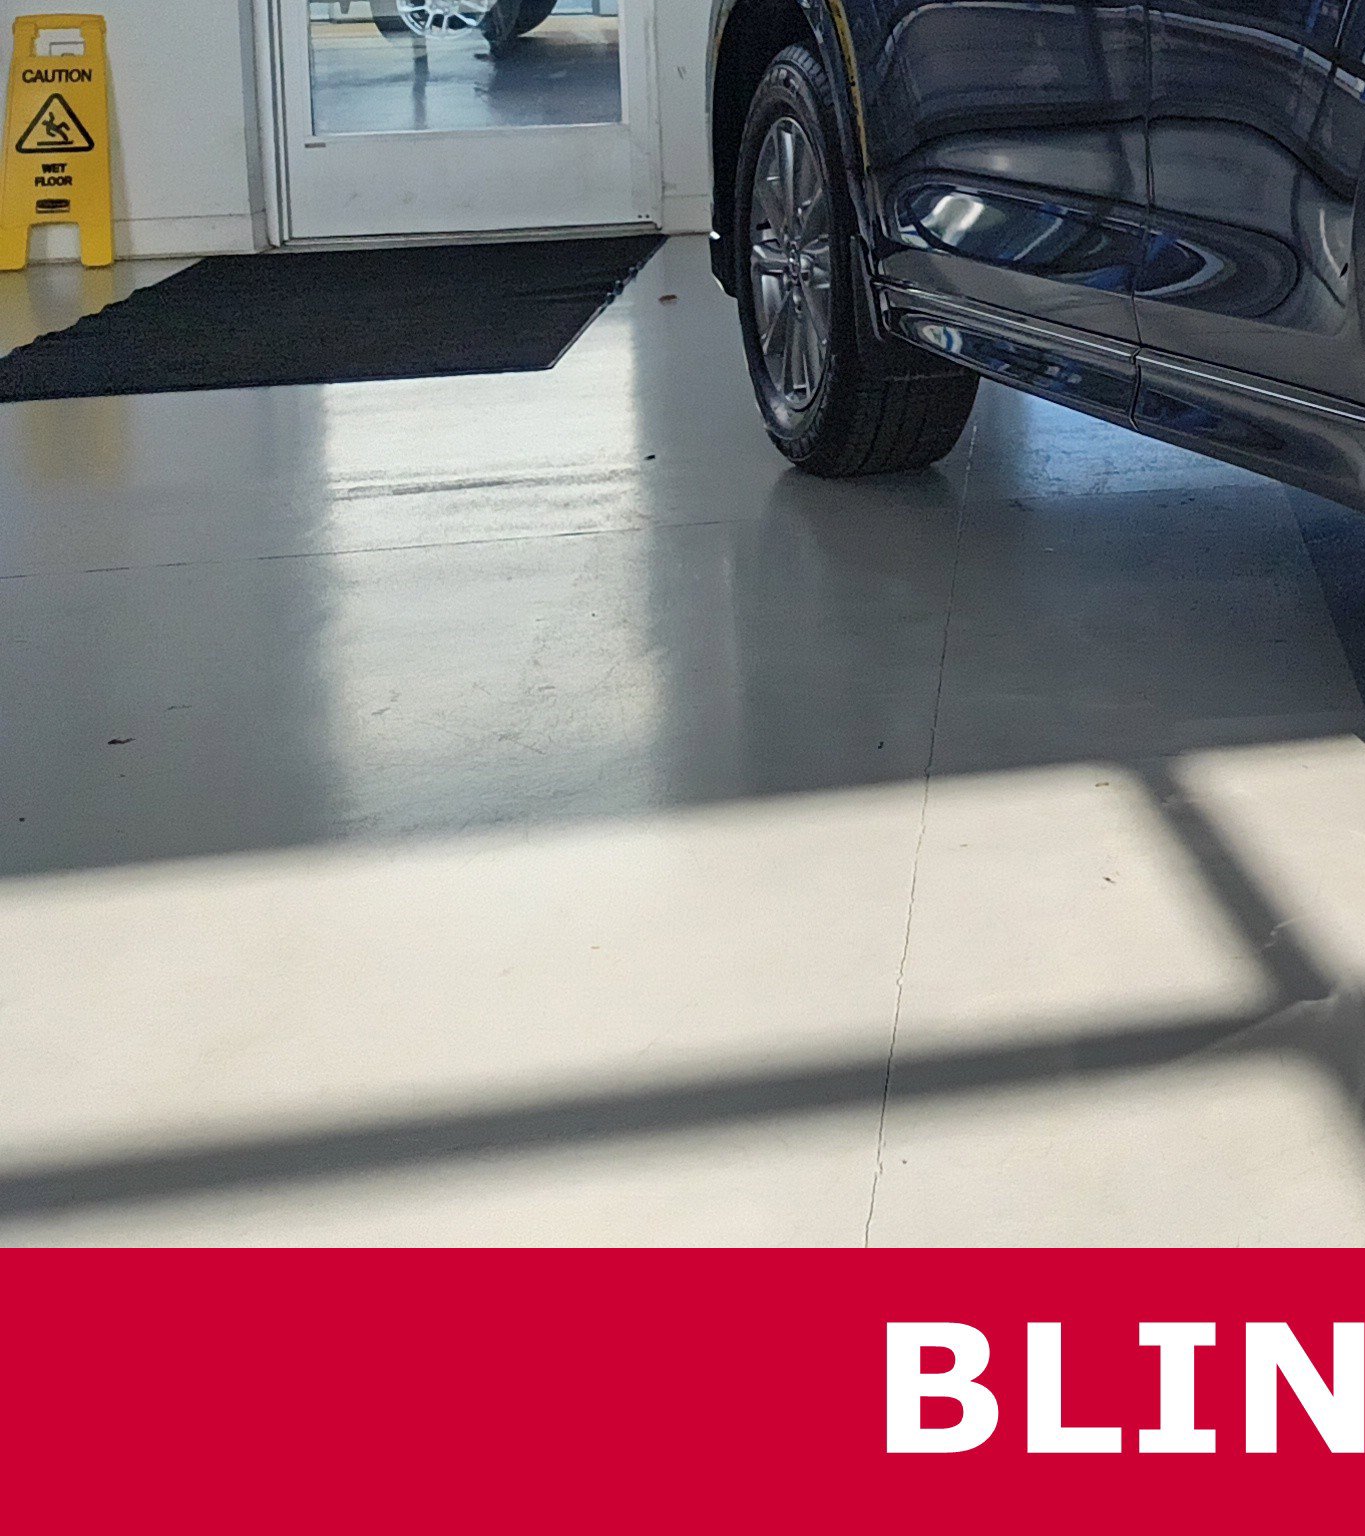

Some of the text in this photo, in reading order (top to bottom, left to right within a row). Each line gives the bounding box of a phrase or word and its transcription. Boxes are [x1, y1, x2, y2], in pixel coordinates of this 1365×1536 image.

[21, 68, 93, 84] CAUTION
[41, 163, 68, 174] WET
[34, 176, 73, 188] FLOOR
